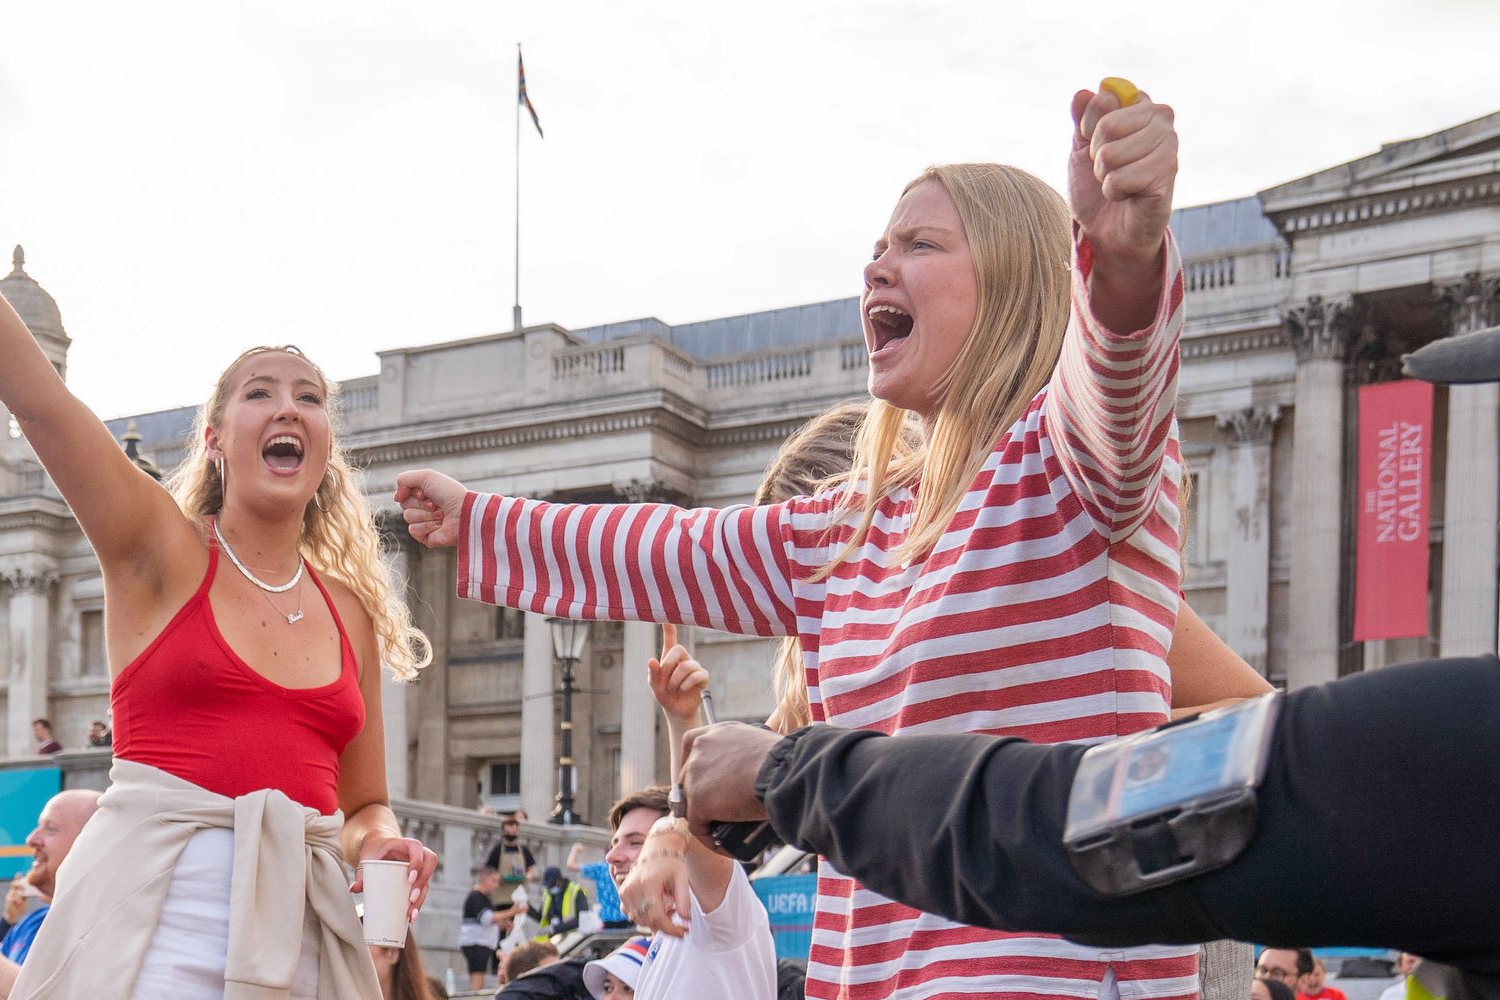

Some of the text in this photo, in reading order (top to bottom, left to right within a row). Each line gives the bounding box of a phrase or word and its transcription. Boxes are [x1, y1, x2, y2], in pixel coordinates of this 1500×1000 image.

[1377, 421, 1398, 542] NATIONAL
[1398, 421, 1422, 541] GALLERY
[768, 893, 807, 913] UEFA
